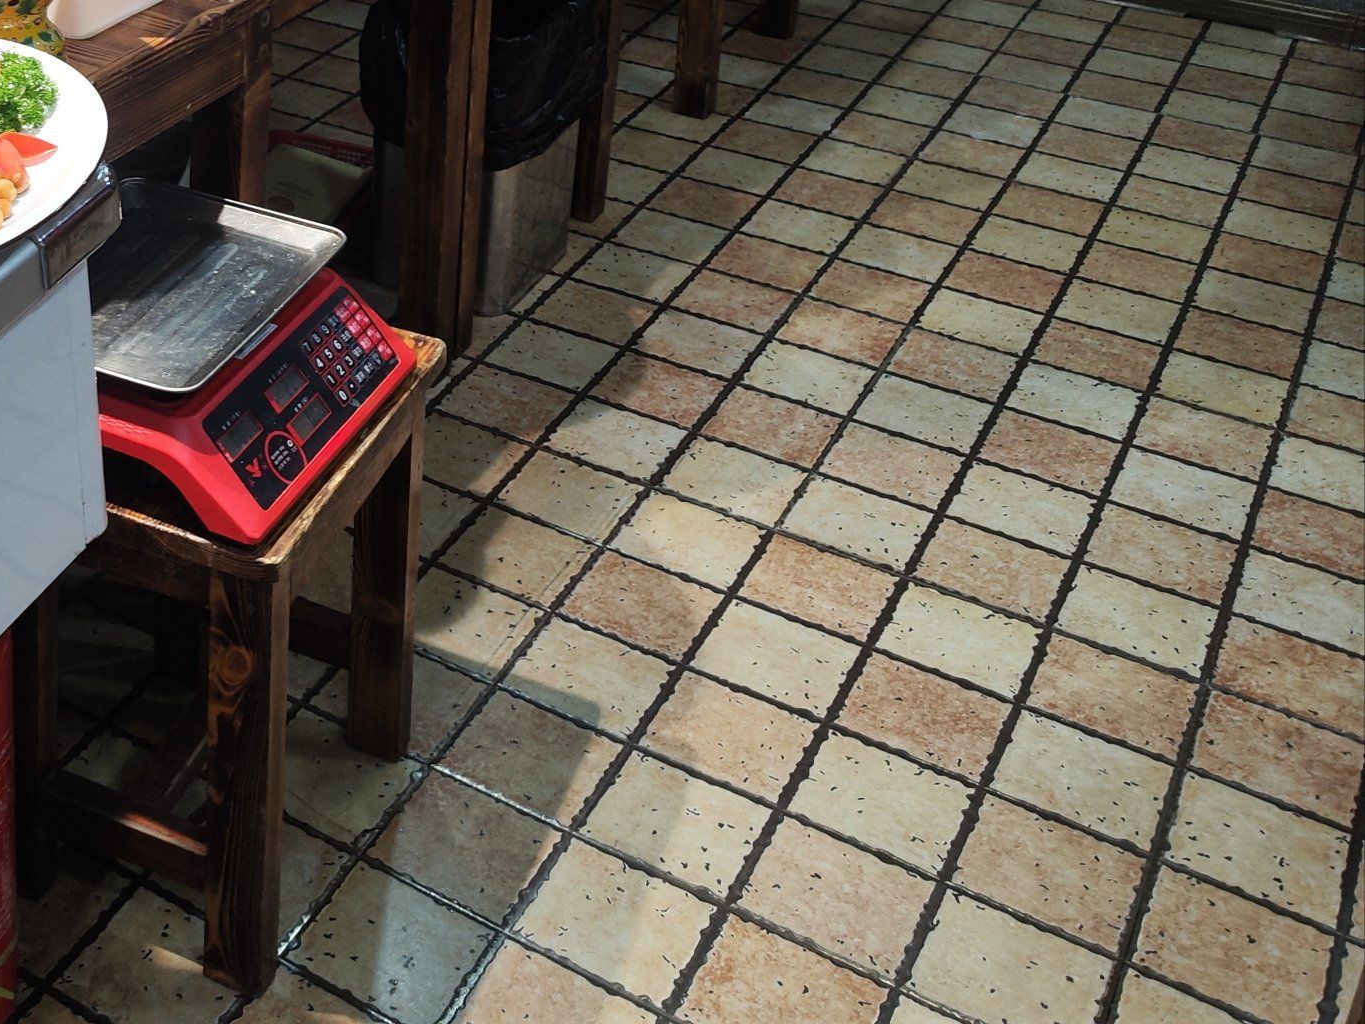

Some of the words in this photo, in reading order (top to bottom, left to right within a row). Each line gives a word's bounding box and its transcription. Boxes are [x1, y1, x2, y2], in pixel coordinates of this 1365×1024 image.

[303, 342, 312, 352] 7
[312, 333, 321, 343] 8
[320, 324, 330, 334] 9
[316, 358, 324, 368] 4
[324, 349, 333, 359] 5
[333, 339, 342, 349] 6
[327, 375, 335, 384] 1
[336, 365, 345, 376] 2
[345, 356, 354, 366] 3
[338, 390, 348, 401] 0
